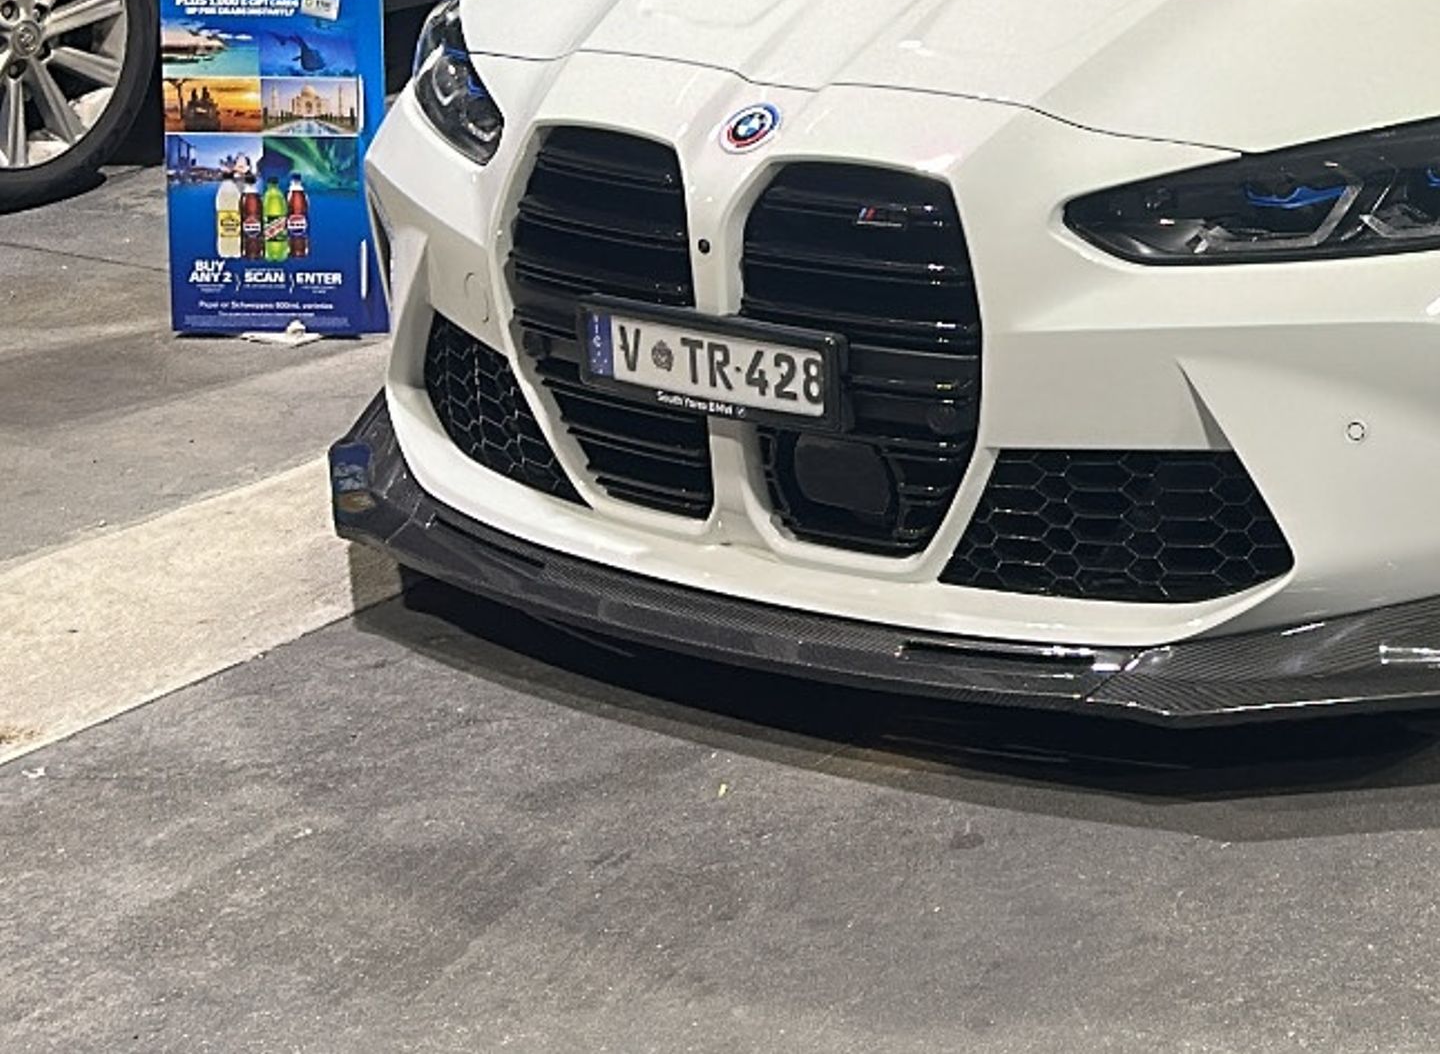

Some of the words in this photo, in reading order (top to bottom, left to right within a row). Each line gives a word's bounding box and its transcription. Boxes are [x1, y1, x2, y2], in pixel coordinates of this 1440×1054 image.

[195, 260, 225, 272] BUY
[188, 272, 222, 283] ANY
[222, 272, 233, 283] 2
[244, 271, 285, 283] SCAN
[295, 272, 342, 285] ENTER
[618, 324, 642, 373] V
